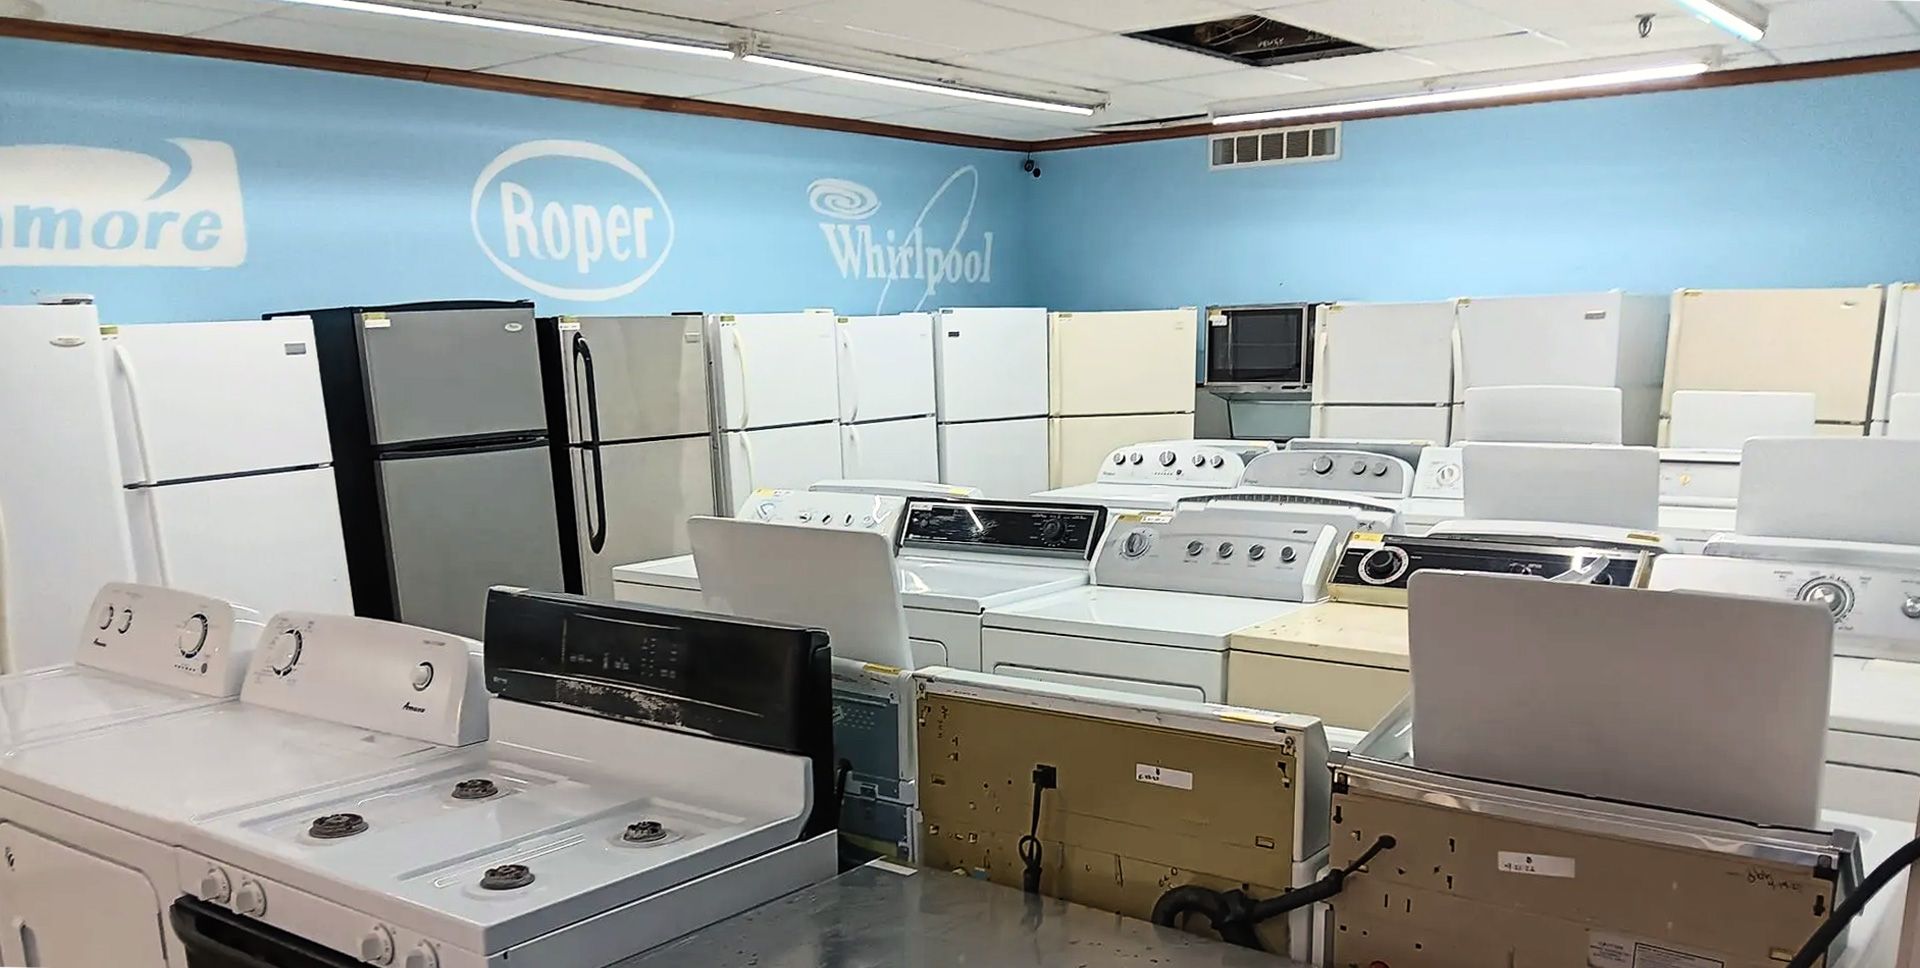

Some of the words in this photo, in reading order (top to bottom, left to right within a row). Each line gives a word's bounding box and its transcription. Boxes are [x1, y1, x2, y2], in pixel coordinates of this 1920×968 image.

[0, 204, 223, 252] more
[501, 181, 654, 274] Roper
[819, 222, 995, 296] Whirlpool
